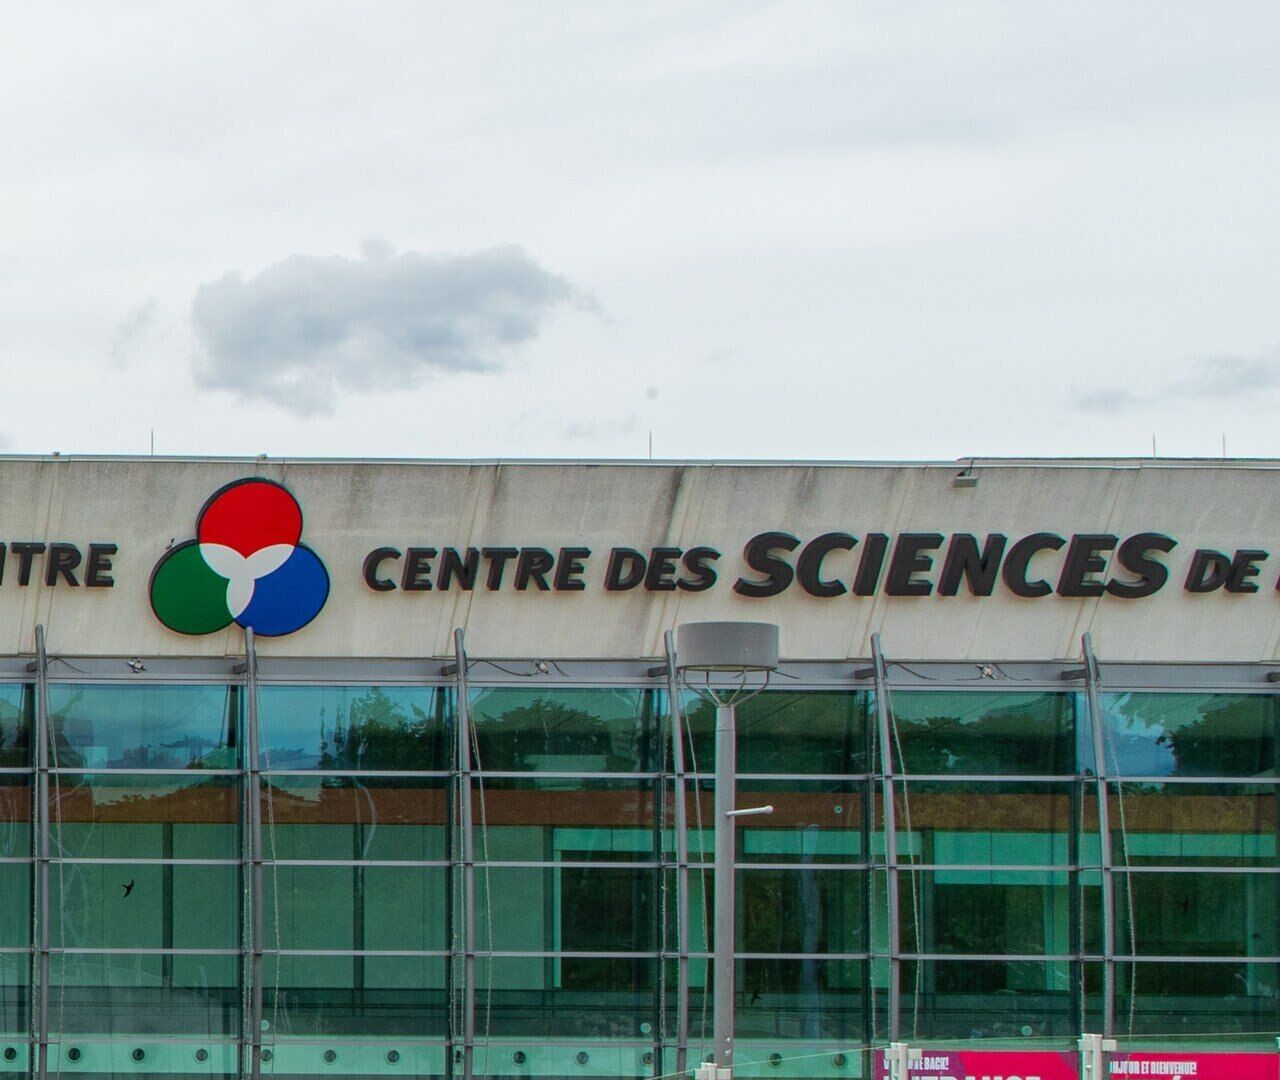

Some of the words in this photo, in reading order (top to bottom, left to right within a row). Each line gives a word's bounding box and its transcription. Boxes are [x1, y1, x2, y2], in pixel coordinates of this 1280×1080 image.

[362, 546, 592, 592] CENTRE
[604, 546, 722, 593] DES
[732, 531, 1178, 599] SCIENCES
[1183, 549, 1269, 594] DE
[924, 1057, 949, 1071] BACK!
[1109, 1060, 1139, 1075] NJOUR
[1140, 1061, 1151, 1075] ET
[1151, 1061, 1197, 1076] BIENVENUE!
